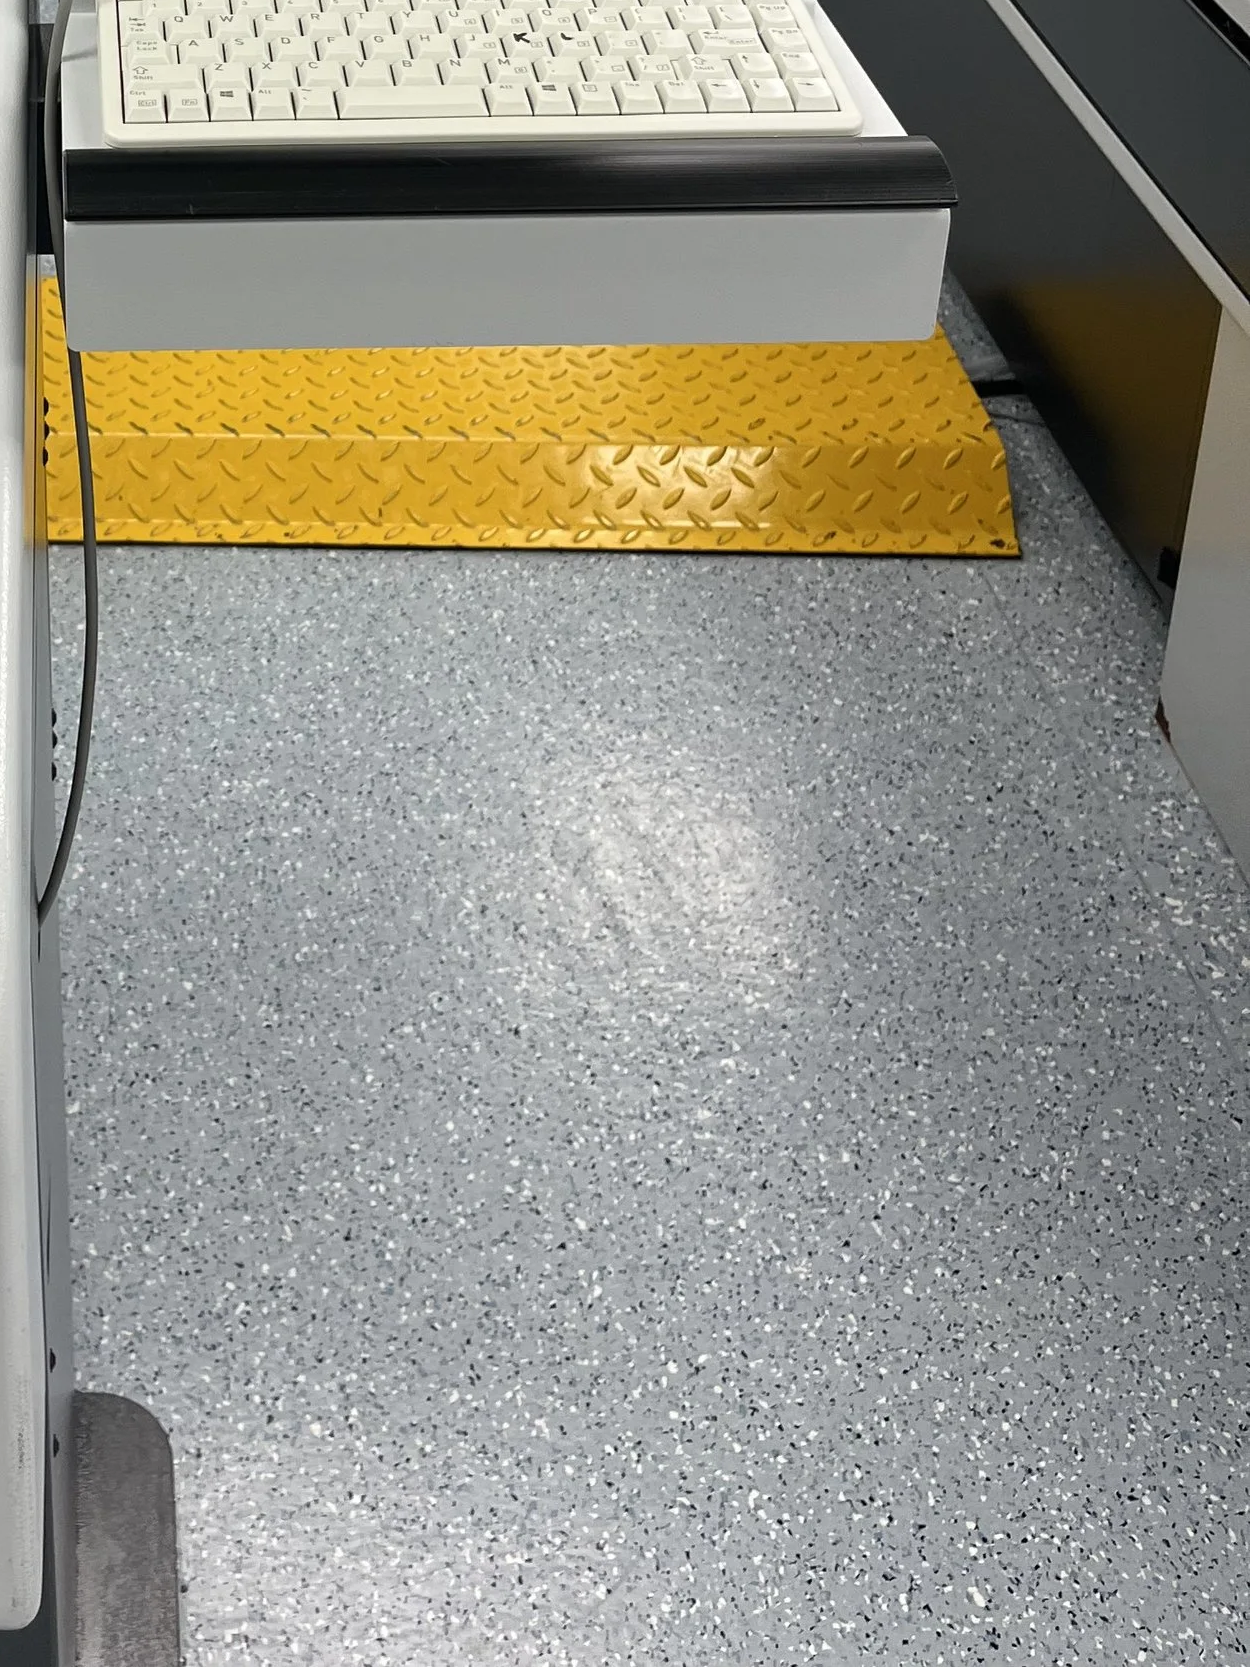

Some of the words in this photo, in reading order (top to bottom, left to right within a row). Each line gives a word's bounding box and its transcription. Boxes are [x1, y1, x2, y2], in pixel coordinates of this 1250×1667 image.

[450, 59, 461, 67] N
[498, 58, 510, 66] M
[215, 63, 224, 71] Z
